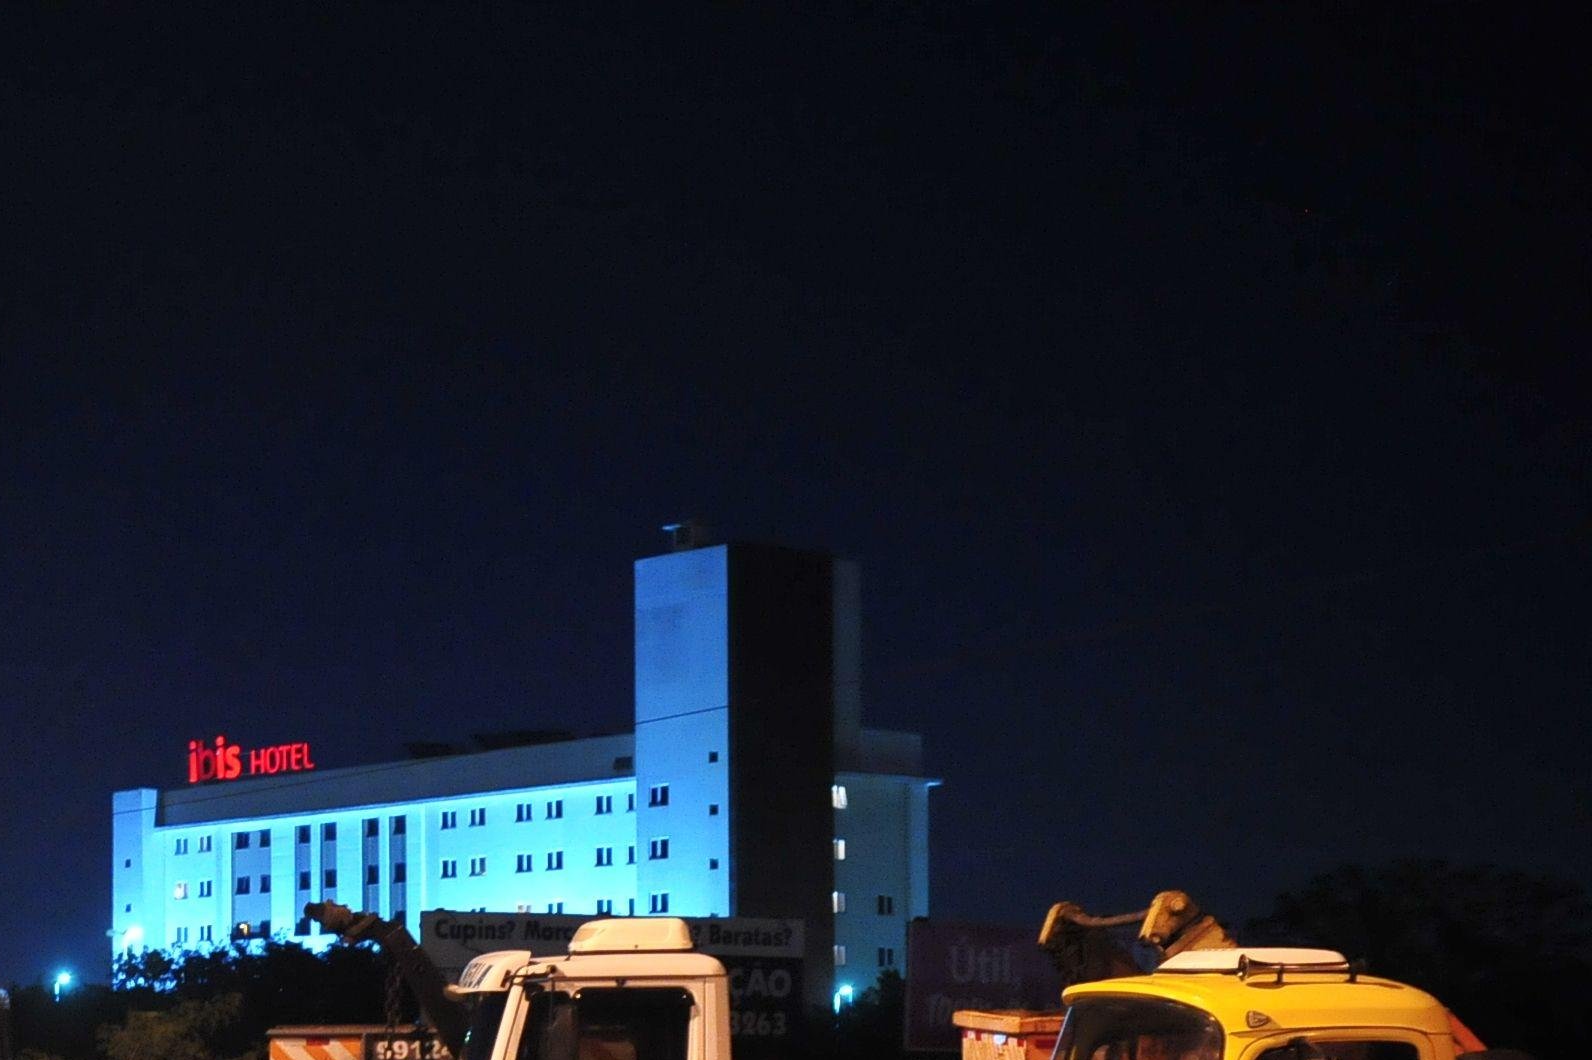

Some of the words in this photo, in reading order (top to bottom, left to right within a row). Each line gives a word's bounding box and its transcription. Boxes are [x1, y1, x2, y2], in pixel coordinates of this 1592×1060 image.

[188, 735, 242, 783] ibis
[250, 742, 315, 775] HOTEL
[435, 919, 515, 944] Cupins?
[710, 924, 793, 947] Baratas?
